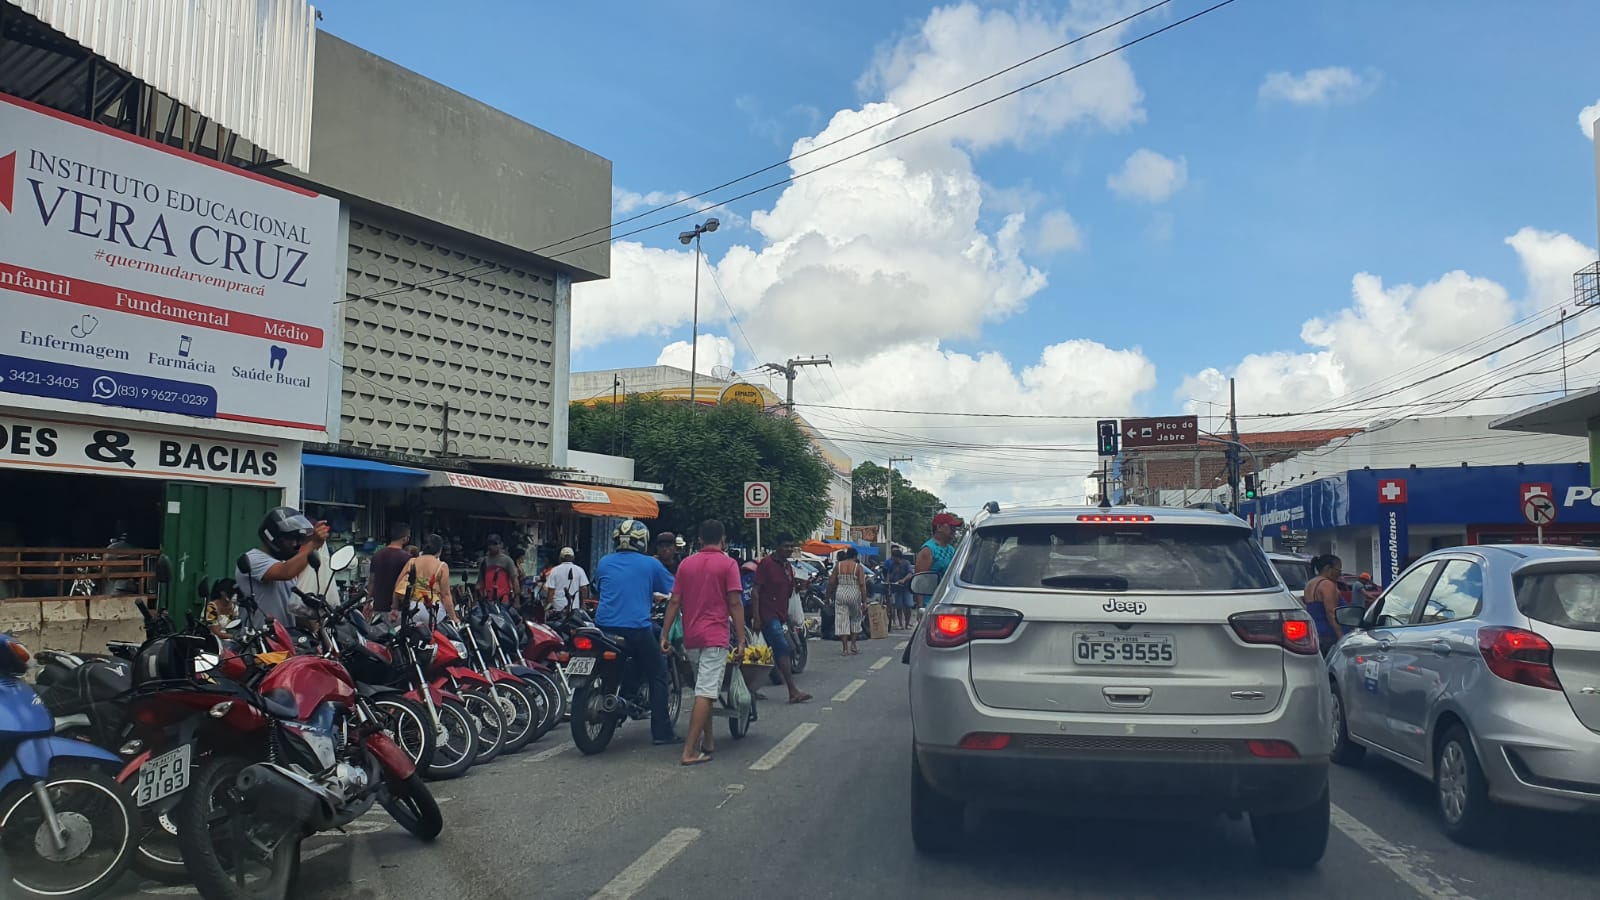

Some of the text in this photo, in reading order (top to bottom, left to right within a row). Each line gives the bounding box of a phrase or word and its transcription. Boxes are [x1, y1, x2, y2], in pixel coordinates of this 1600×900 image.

[29, 148, 312, 245] INSTITUTO EDUCACIONAL
[26, 177, 309, 287] VERA CRUZ
[94, 248, 266, 297] #quermudarvempracá
[115, 292, 230, 327] Fundamental
[263, 321, 310, 343] Médio
[19, 330, 312, 388] Enfermagem Farmácia Saúde Bucal
[8, 369, 209, 407] 3421-3405 (83) 9 9627-0239
[1156, 420, 1194, 430] Pico do
[1157, 433, 1185, 441] Jabre
[84, 429, 137, 469] &
[158, 439, 279, 477] BACIAS
[448, 473, 518, 494] FERNANDES
[519, 483, 585, 500] VARIEDADES
[752, 488, 762, 502] E
[1103, 598, 1147, 615] Jeep
[142, 773, 184, 803] 3183
